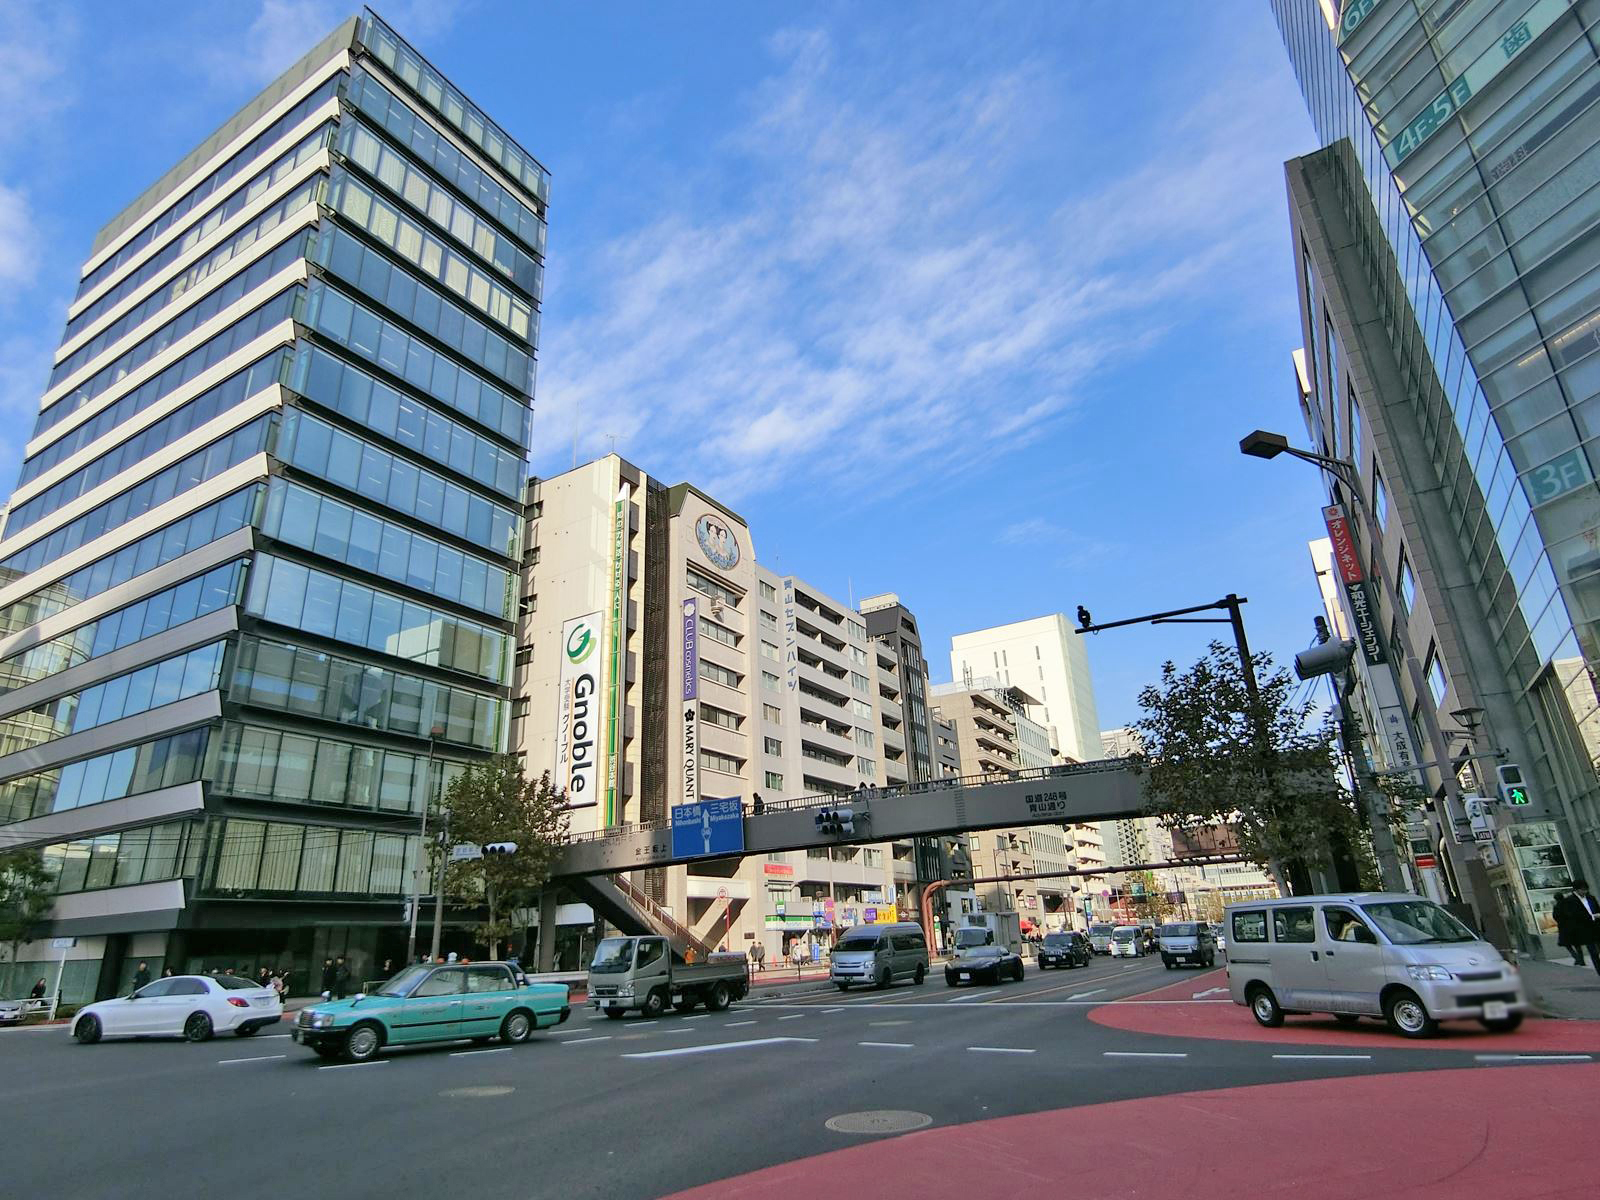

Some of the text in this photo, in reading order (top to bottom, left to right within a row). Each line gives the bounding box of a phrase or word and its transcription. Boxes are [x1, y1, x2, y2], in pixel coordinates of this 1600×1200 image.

[1344, 0, 1374, 31] 6F
[1535, 461, 1577, 500] 3F
[1331, 519, 1359, 581] オレンジネット
[685, 619, 694, 695] CLUB cosmetics
[570, 673, 595, 793] Gnoble
[684, 725, 694, 798] MARY QUANT
[675, 800, 739, 819] 日本橋 三宅坂
[1029, 801, 1066, 813] 青山通り
